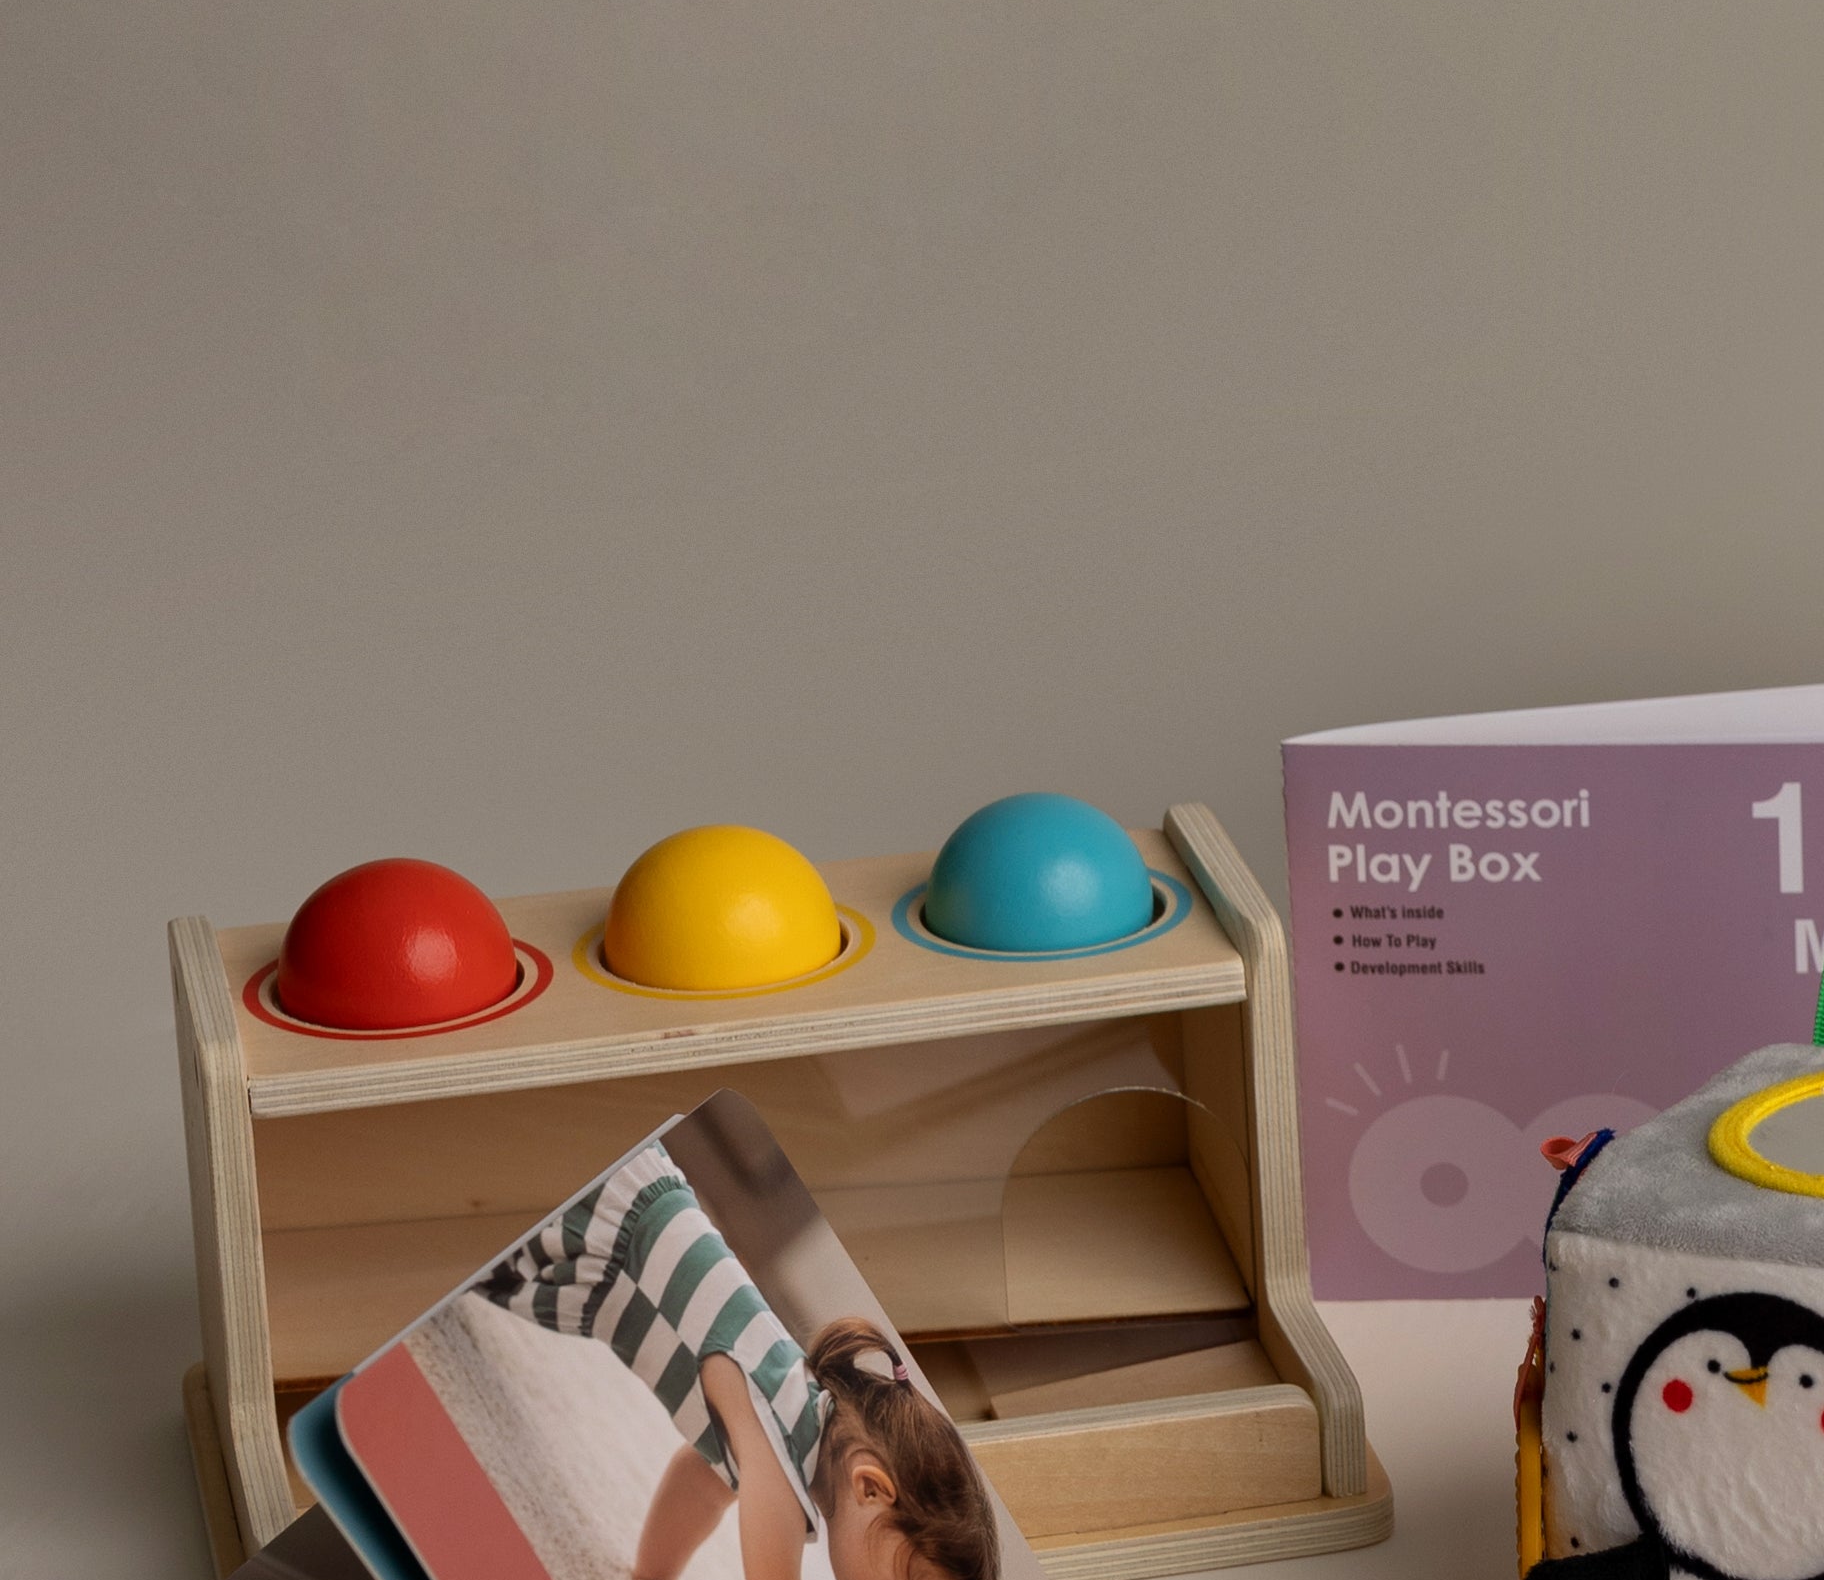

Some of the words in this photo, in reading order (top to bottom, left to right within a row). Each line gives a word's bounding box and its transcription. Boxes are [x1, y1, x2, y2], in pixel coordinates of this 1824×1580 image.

[1328, 789, 1590, 829] Montessori
[1328, 844, 1432, 892] Play
[1449, 843, 1542, 882] Box
[1351, 906, 1397, 919] What's
[1352, 934, 1382, 948] How
[1387, 934, 1402, 948] To
[1406, 934, 1437, 950] Play
[1351, 961, 1443, 976] Development
[1446, 961, 1485, 975] Skills
